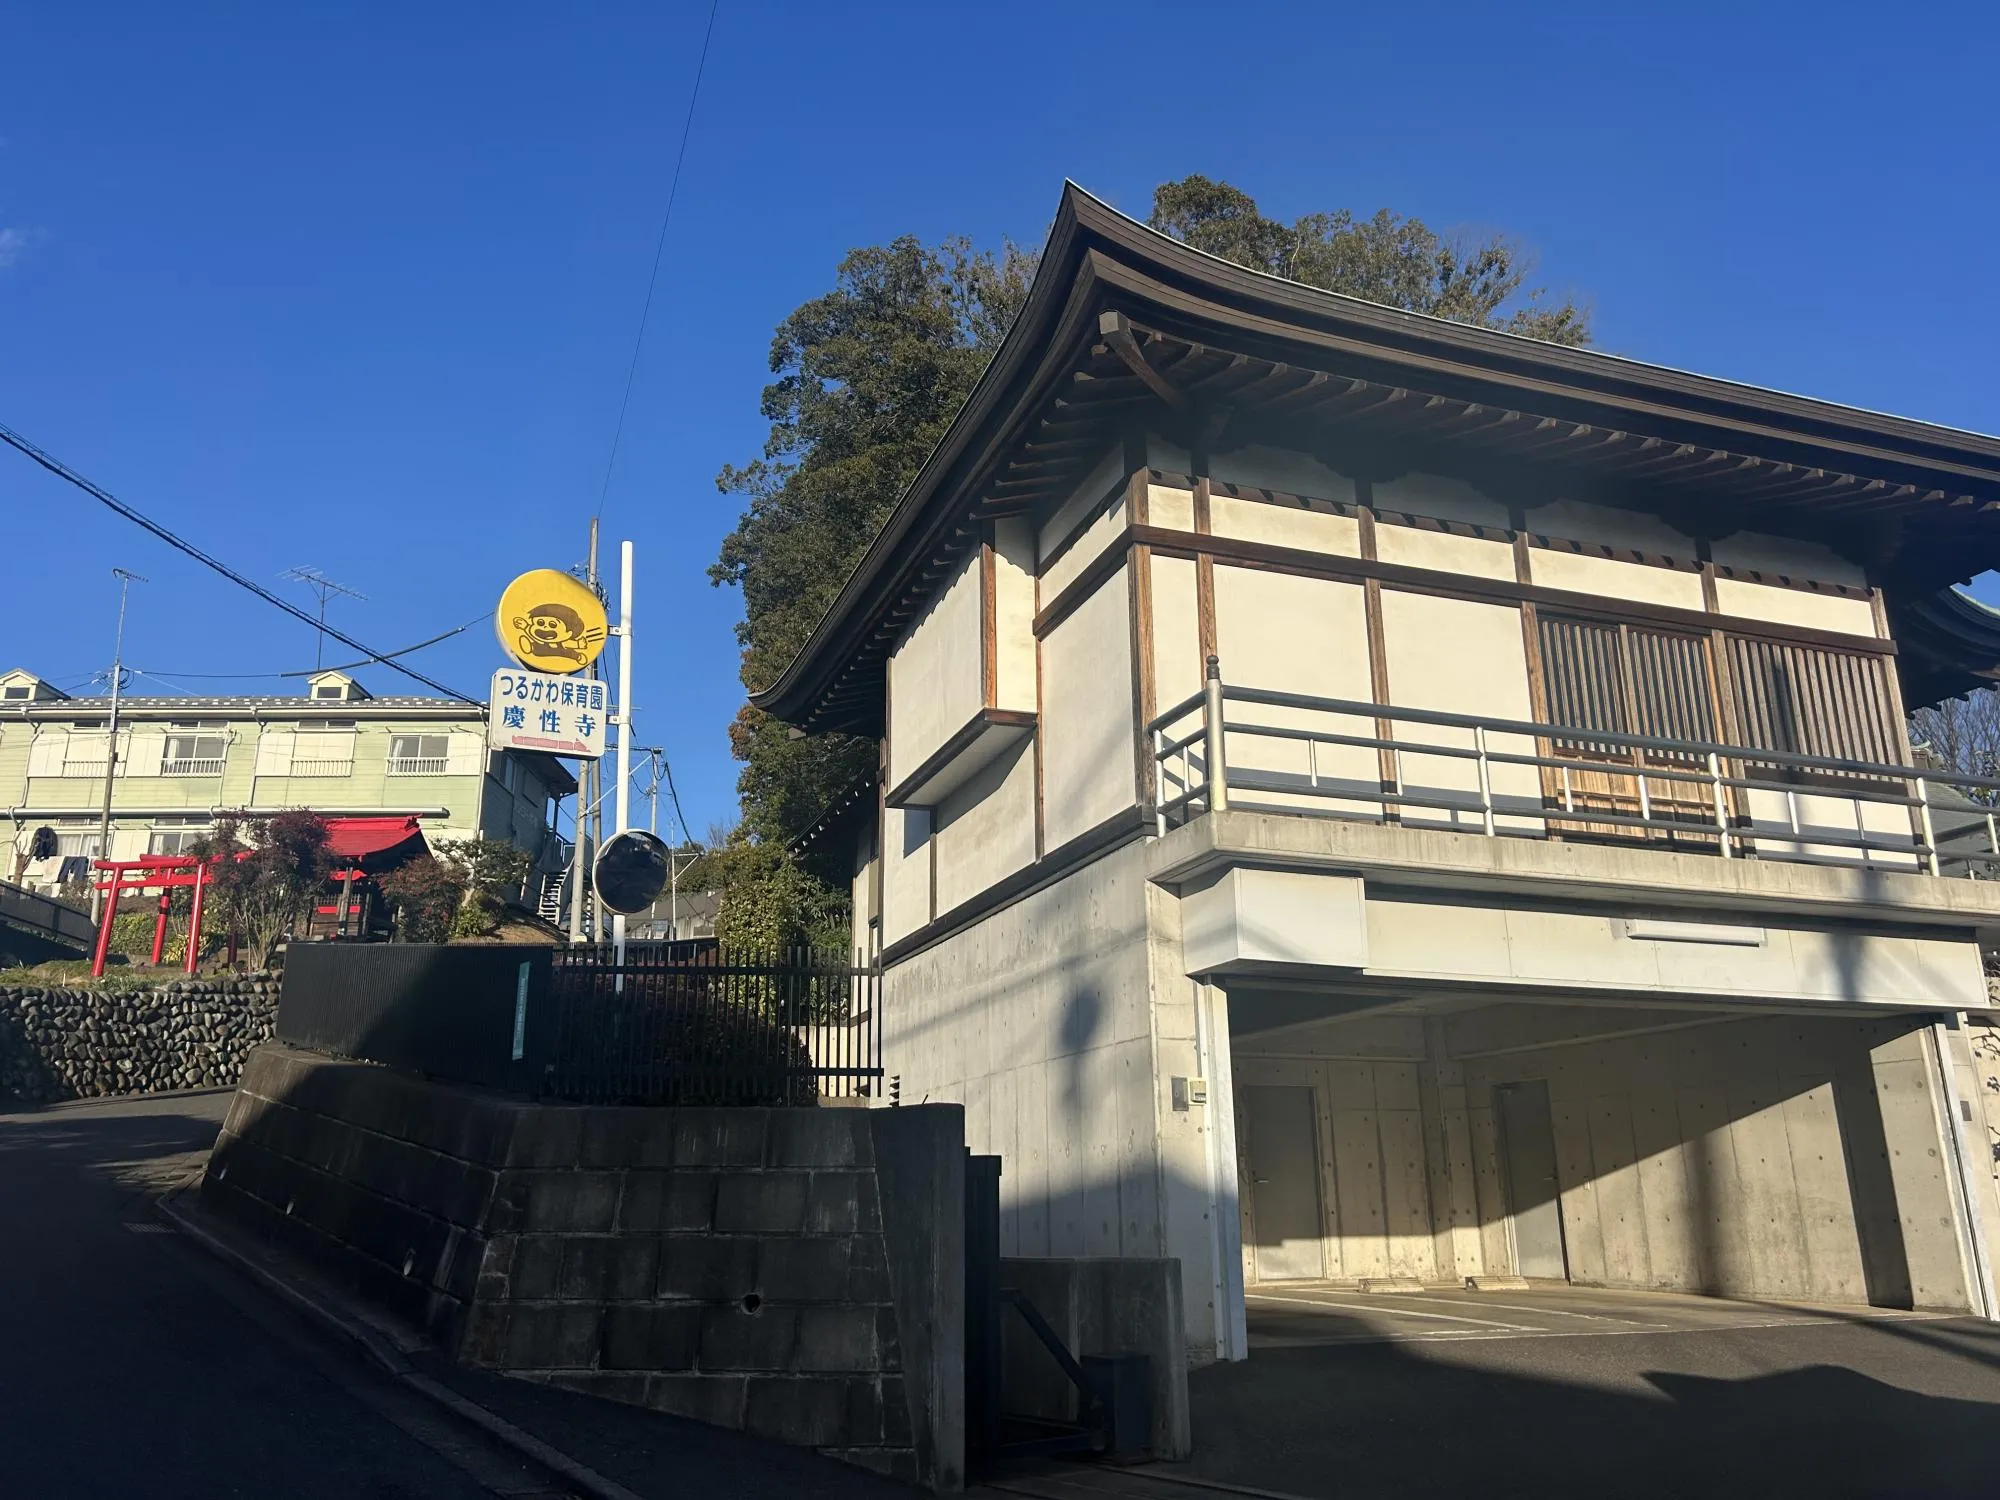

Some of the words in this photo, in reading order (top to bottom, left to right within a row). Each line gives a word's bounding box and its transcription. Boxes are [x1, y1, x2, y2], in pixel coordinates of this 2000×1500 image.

[501, 676, 602, 710] つるかわ保育園
[502, 706, 597, 737] 慶性寺
